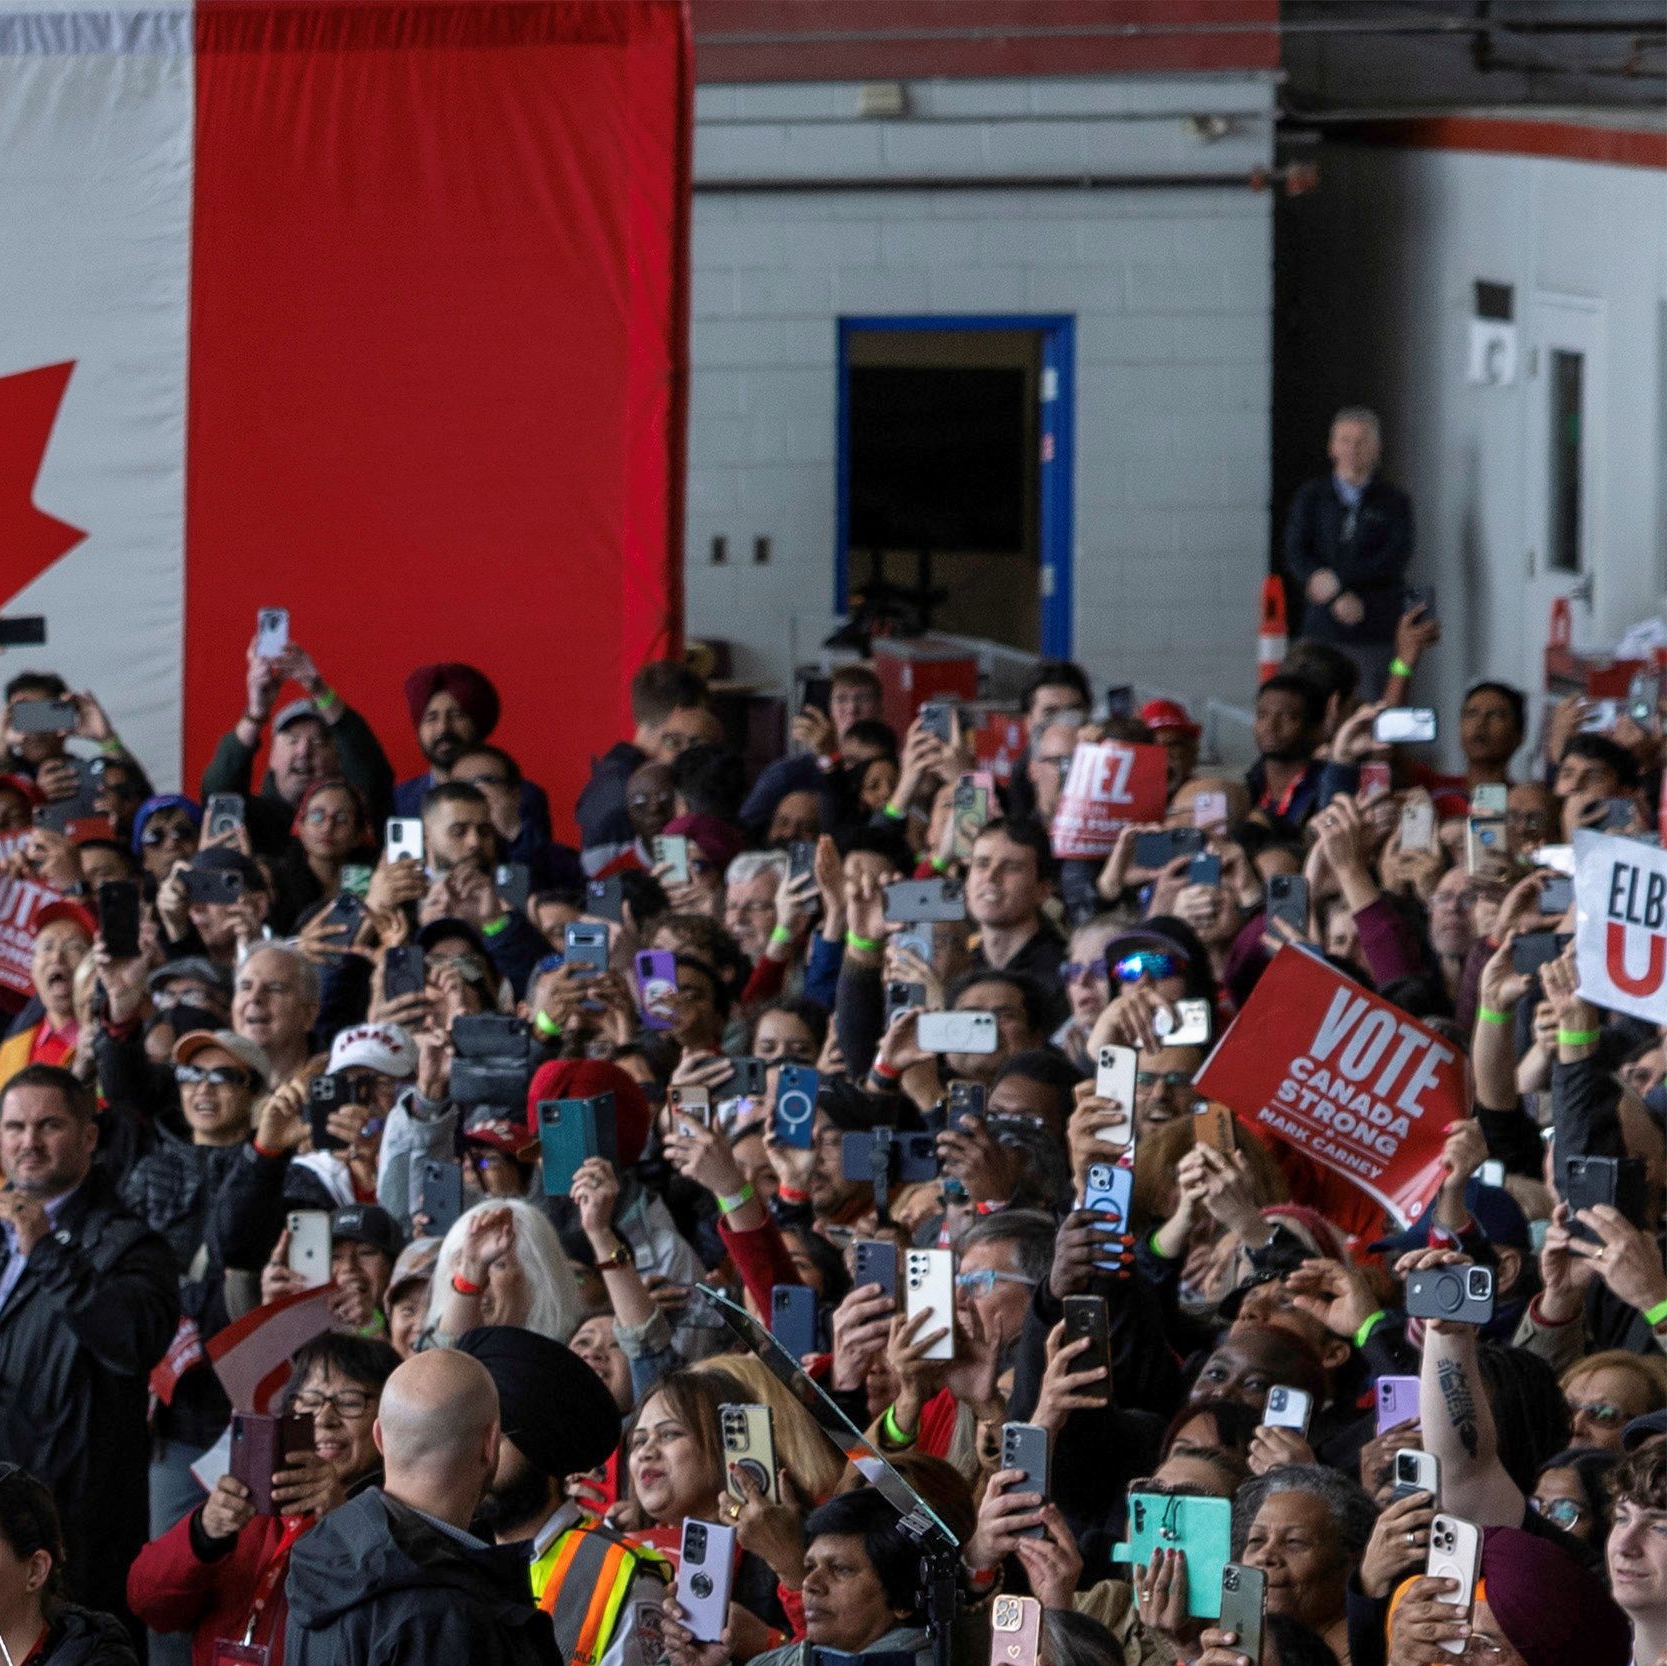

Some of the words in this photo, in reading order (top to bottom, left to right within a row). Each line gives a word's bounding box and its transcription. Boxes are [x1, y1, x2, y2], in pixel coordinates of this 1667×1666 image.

[1608, 861, 1667, 930] ELB
[1605, 920, 1667, 999] U
[1309, 985, 1456, 1119] VOTE
[1277, 1078, 1400, 1159] STRONG
[1289, 1056, 1411, 1140] CANADA
[1258, 1106, 1311, 1143] MARK
[1311, 1135, 1384, 1181] CARNEY
